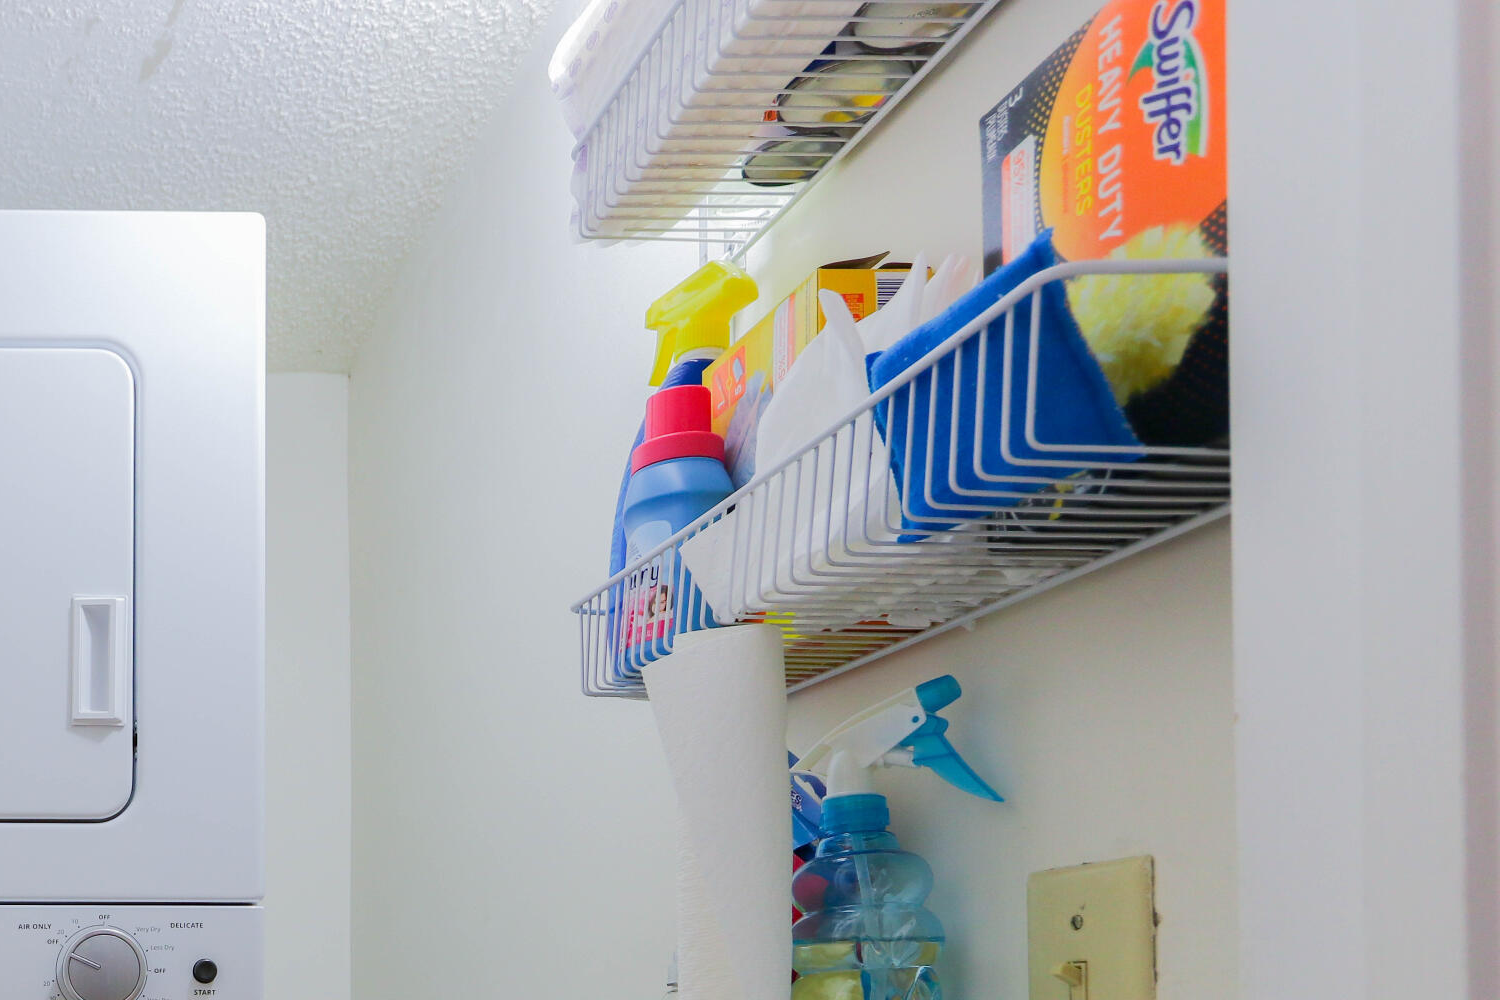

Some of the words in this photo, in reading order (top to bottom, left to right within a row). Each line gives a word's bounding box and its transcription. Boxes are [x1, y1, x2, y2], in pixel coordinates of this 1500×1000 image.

[1098, 14, 1123, 134] HEAVY
[1143, 0, 1195, 162] Swiffer
[1075, 83, 1093, 216] DUSTERS
[1098, 144, 1123, 240] DUTY
